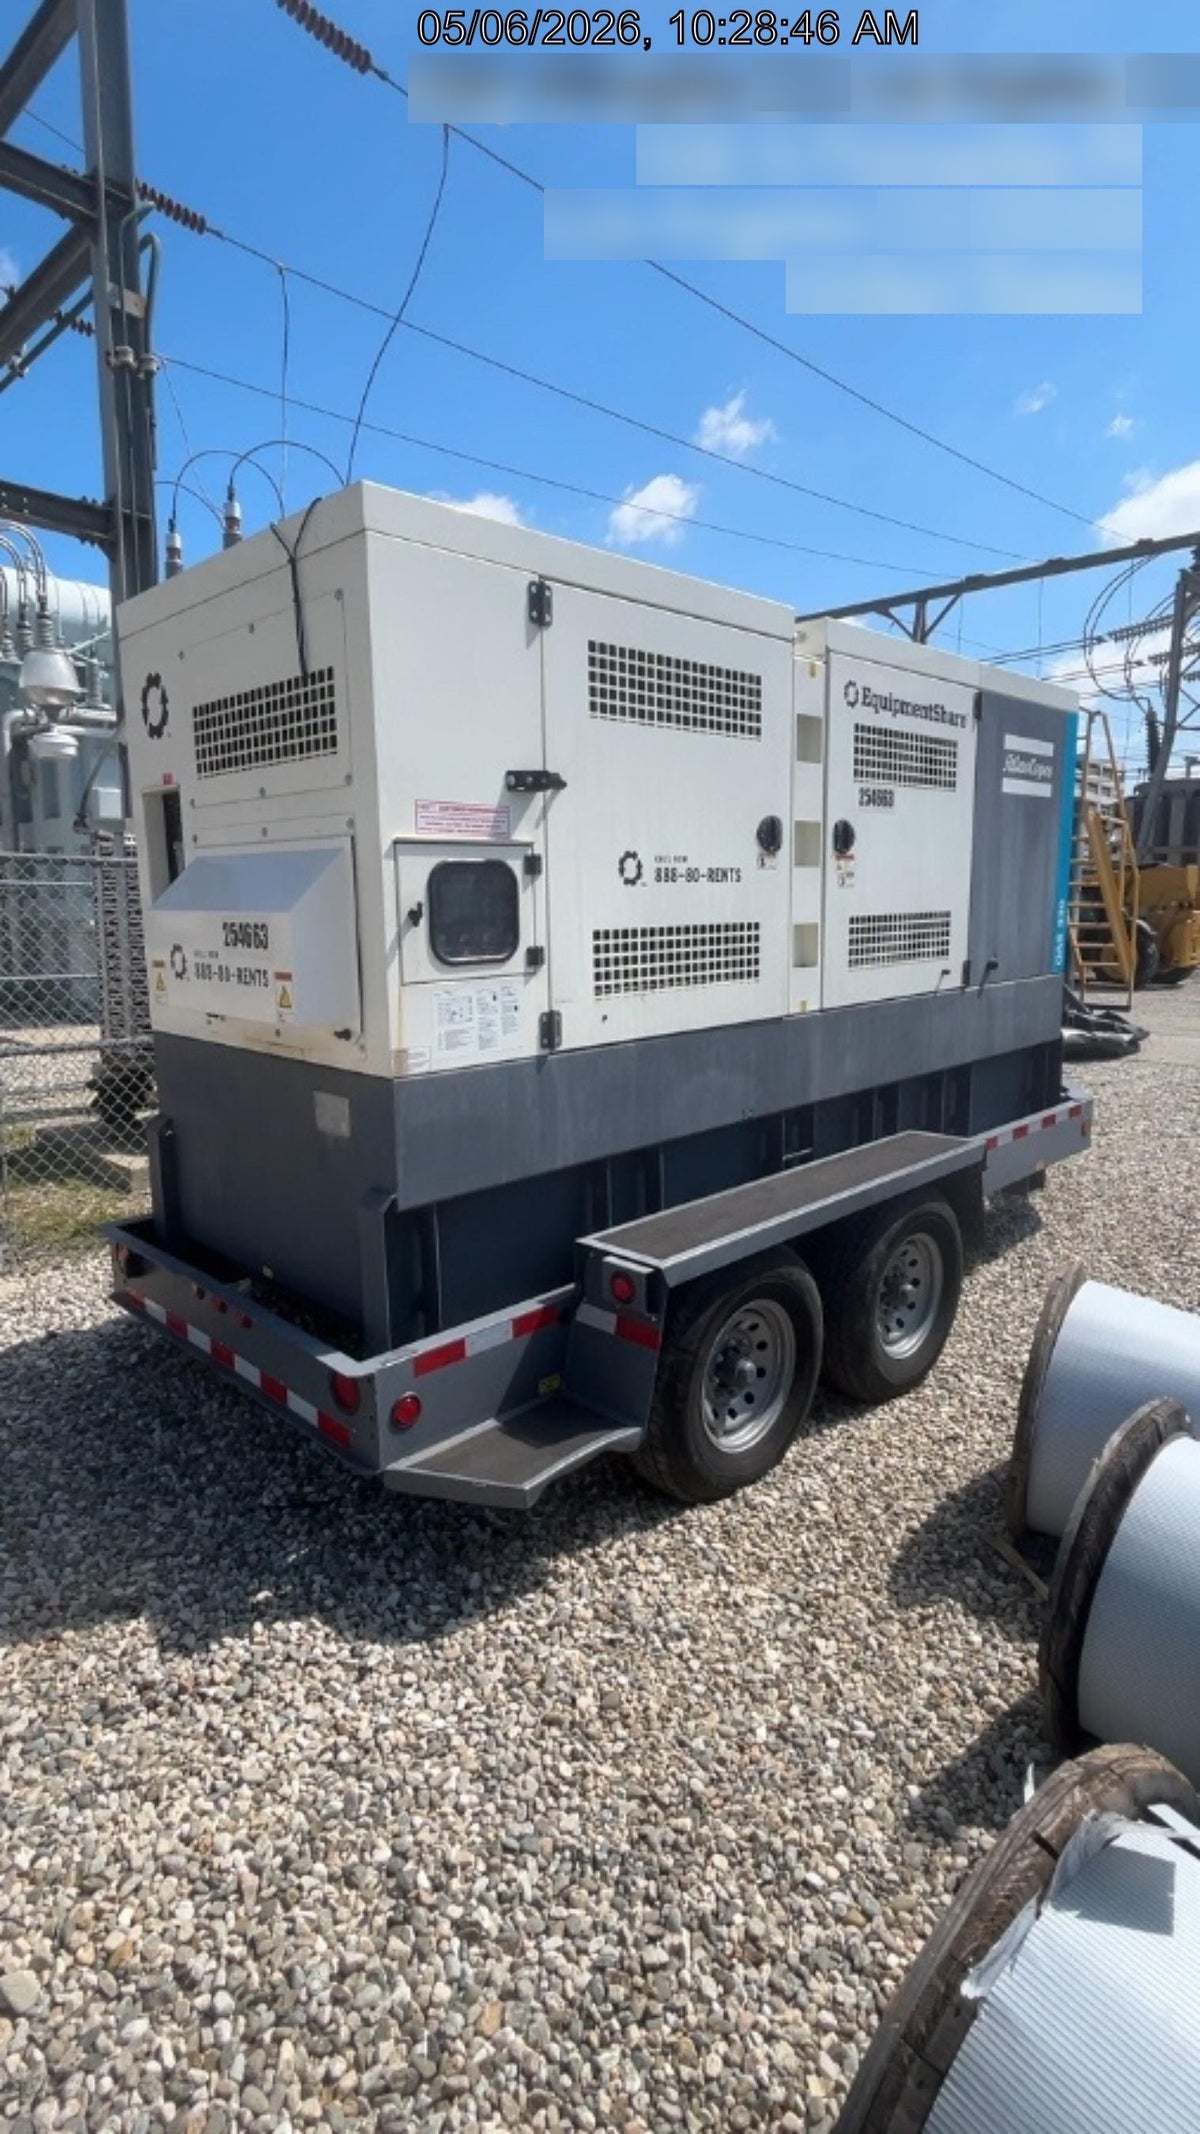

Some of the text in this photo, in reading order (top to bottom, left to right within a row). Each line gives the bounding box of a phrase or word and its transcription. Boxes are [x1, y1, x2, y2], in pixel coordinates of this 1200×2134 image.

[862, 686, 966, 728] EquipmentShare
[859, 787, 894, 807] 254663
[655, 867, 741, 883] 888-80-RENTS
[223, 922, 268, 950] 254663
[195, 962, 269, 988] 888-80-RENTS
